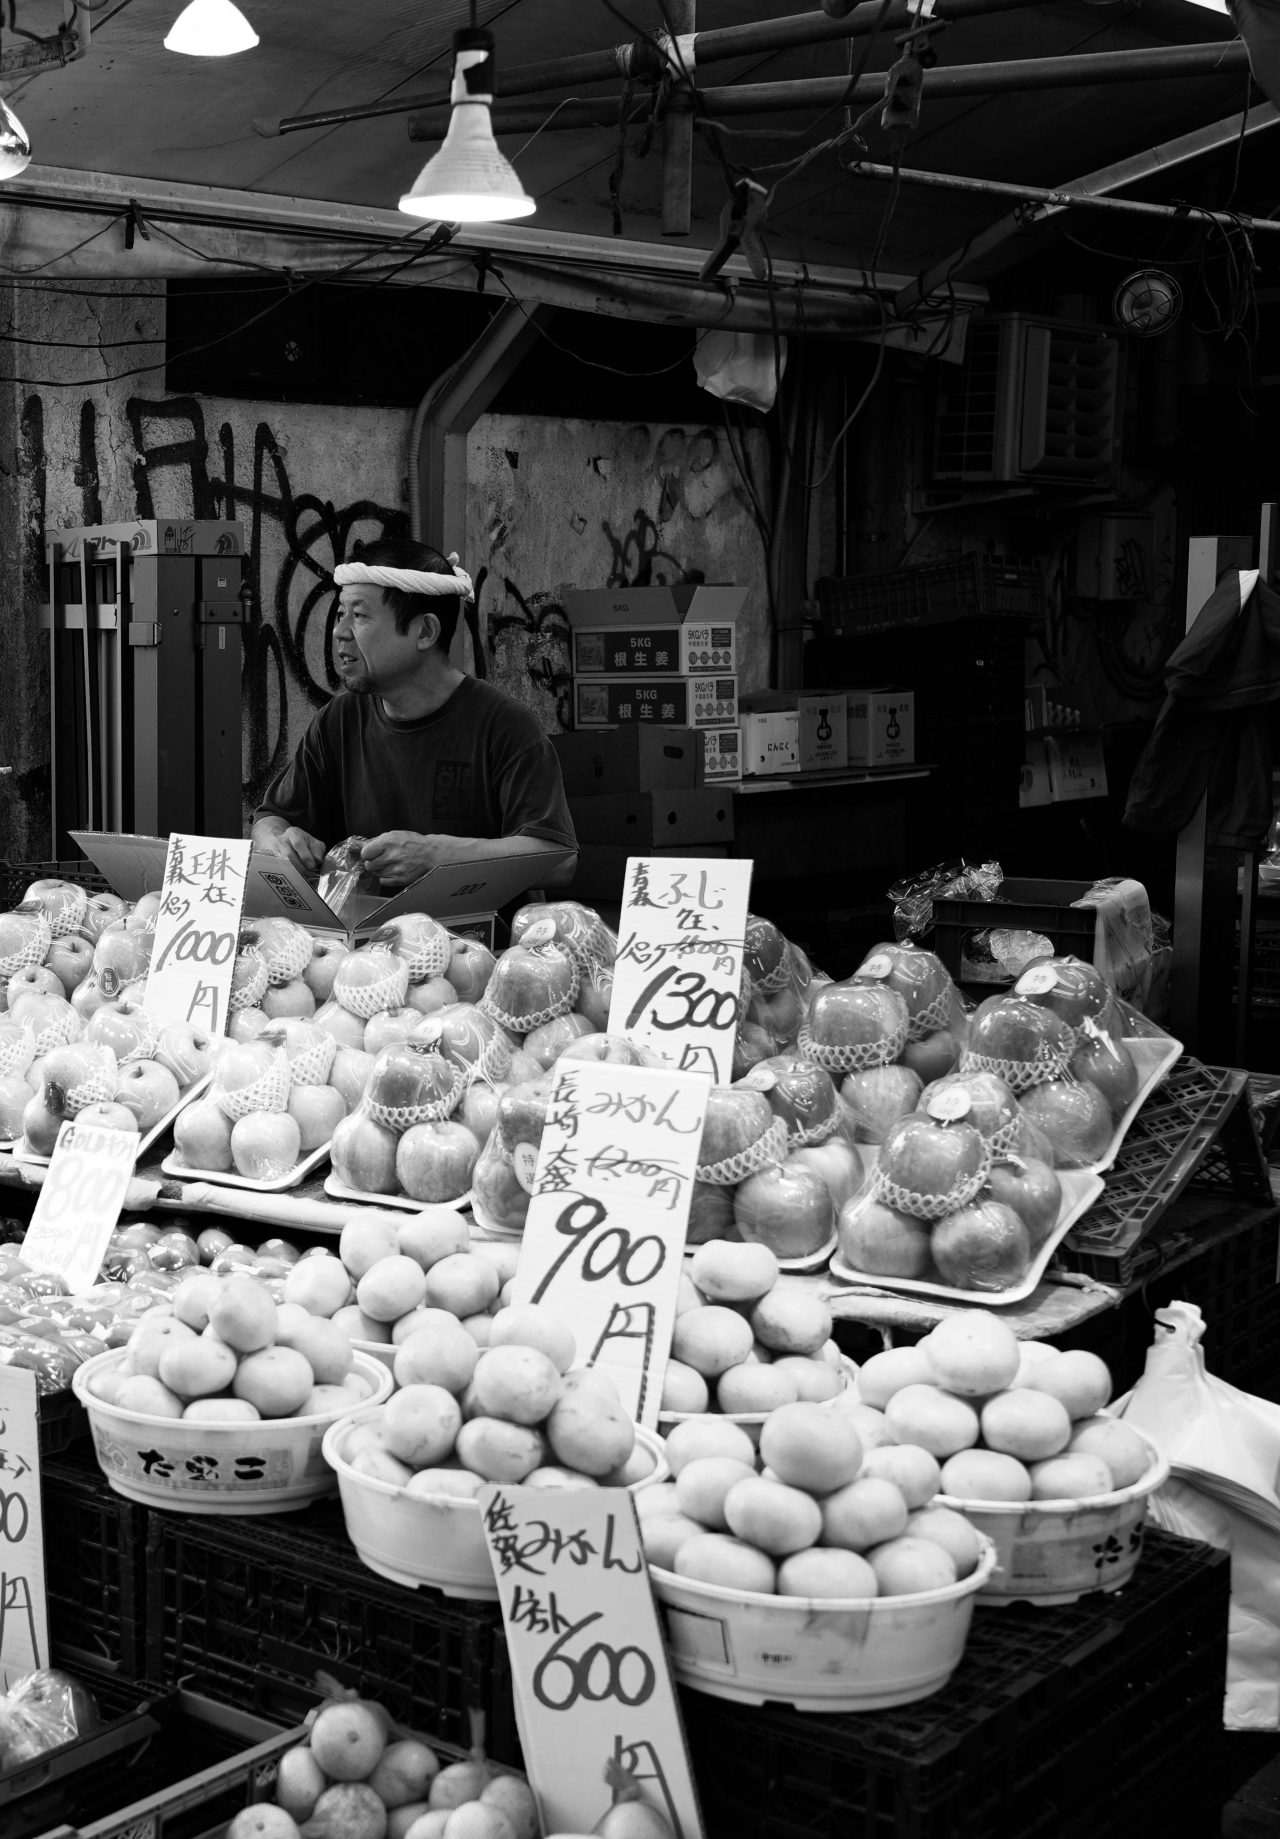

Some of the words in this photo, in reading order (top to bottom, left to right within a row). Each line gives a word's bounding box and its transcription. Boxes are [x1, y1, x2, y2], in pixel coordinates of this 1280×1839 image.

[613, 650, 671, 667] 根生姜
[630, 637, 652, 648] 5KG
[618, 703, 676, 720] 根生姜
[635, 689, 658, 701] 5KG
[186, 848, 246, 882] 王林
[657, 869, 728, 910] ふじ
[185, 979, 219, 1033] 円
[585, 1089, 702, 1134] みかん
[40, 1155, 125, 1222] 800
[529, 1196, 667, 1305] 900
[585, 1301, 657, 1426] 円
[483, 1490, 546, 1577] 佐賀
[522, 1513, 645, 1575] みかん
[532, 1611, 657, 1712] 600
